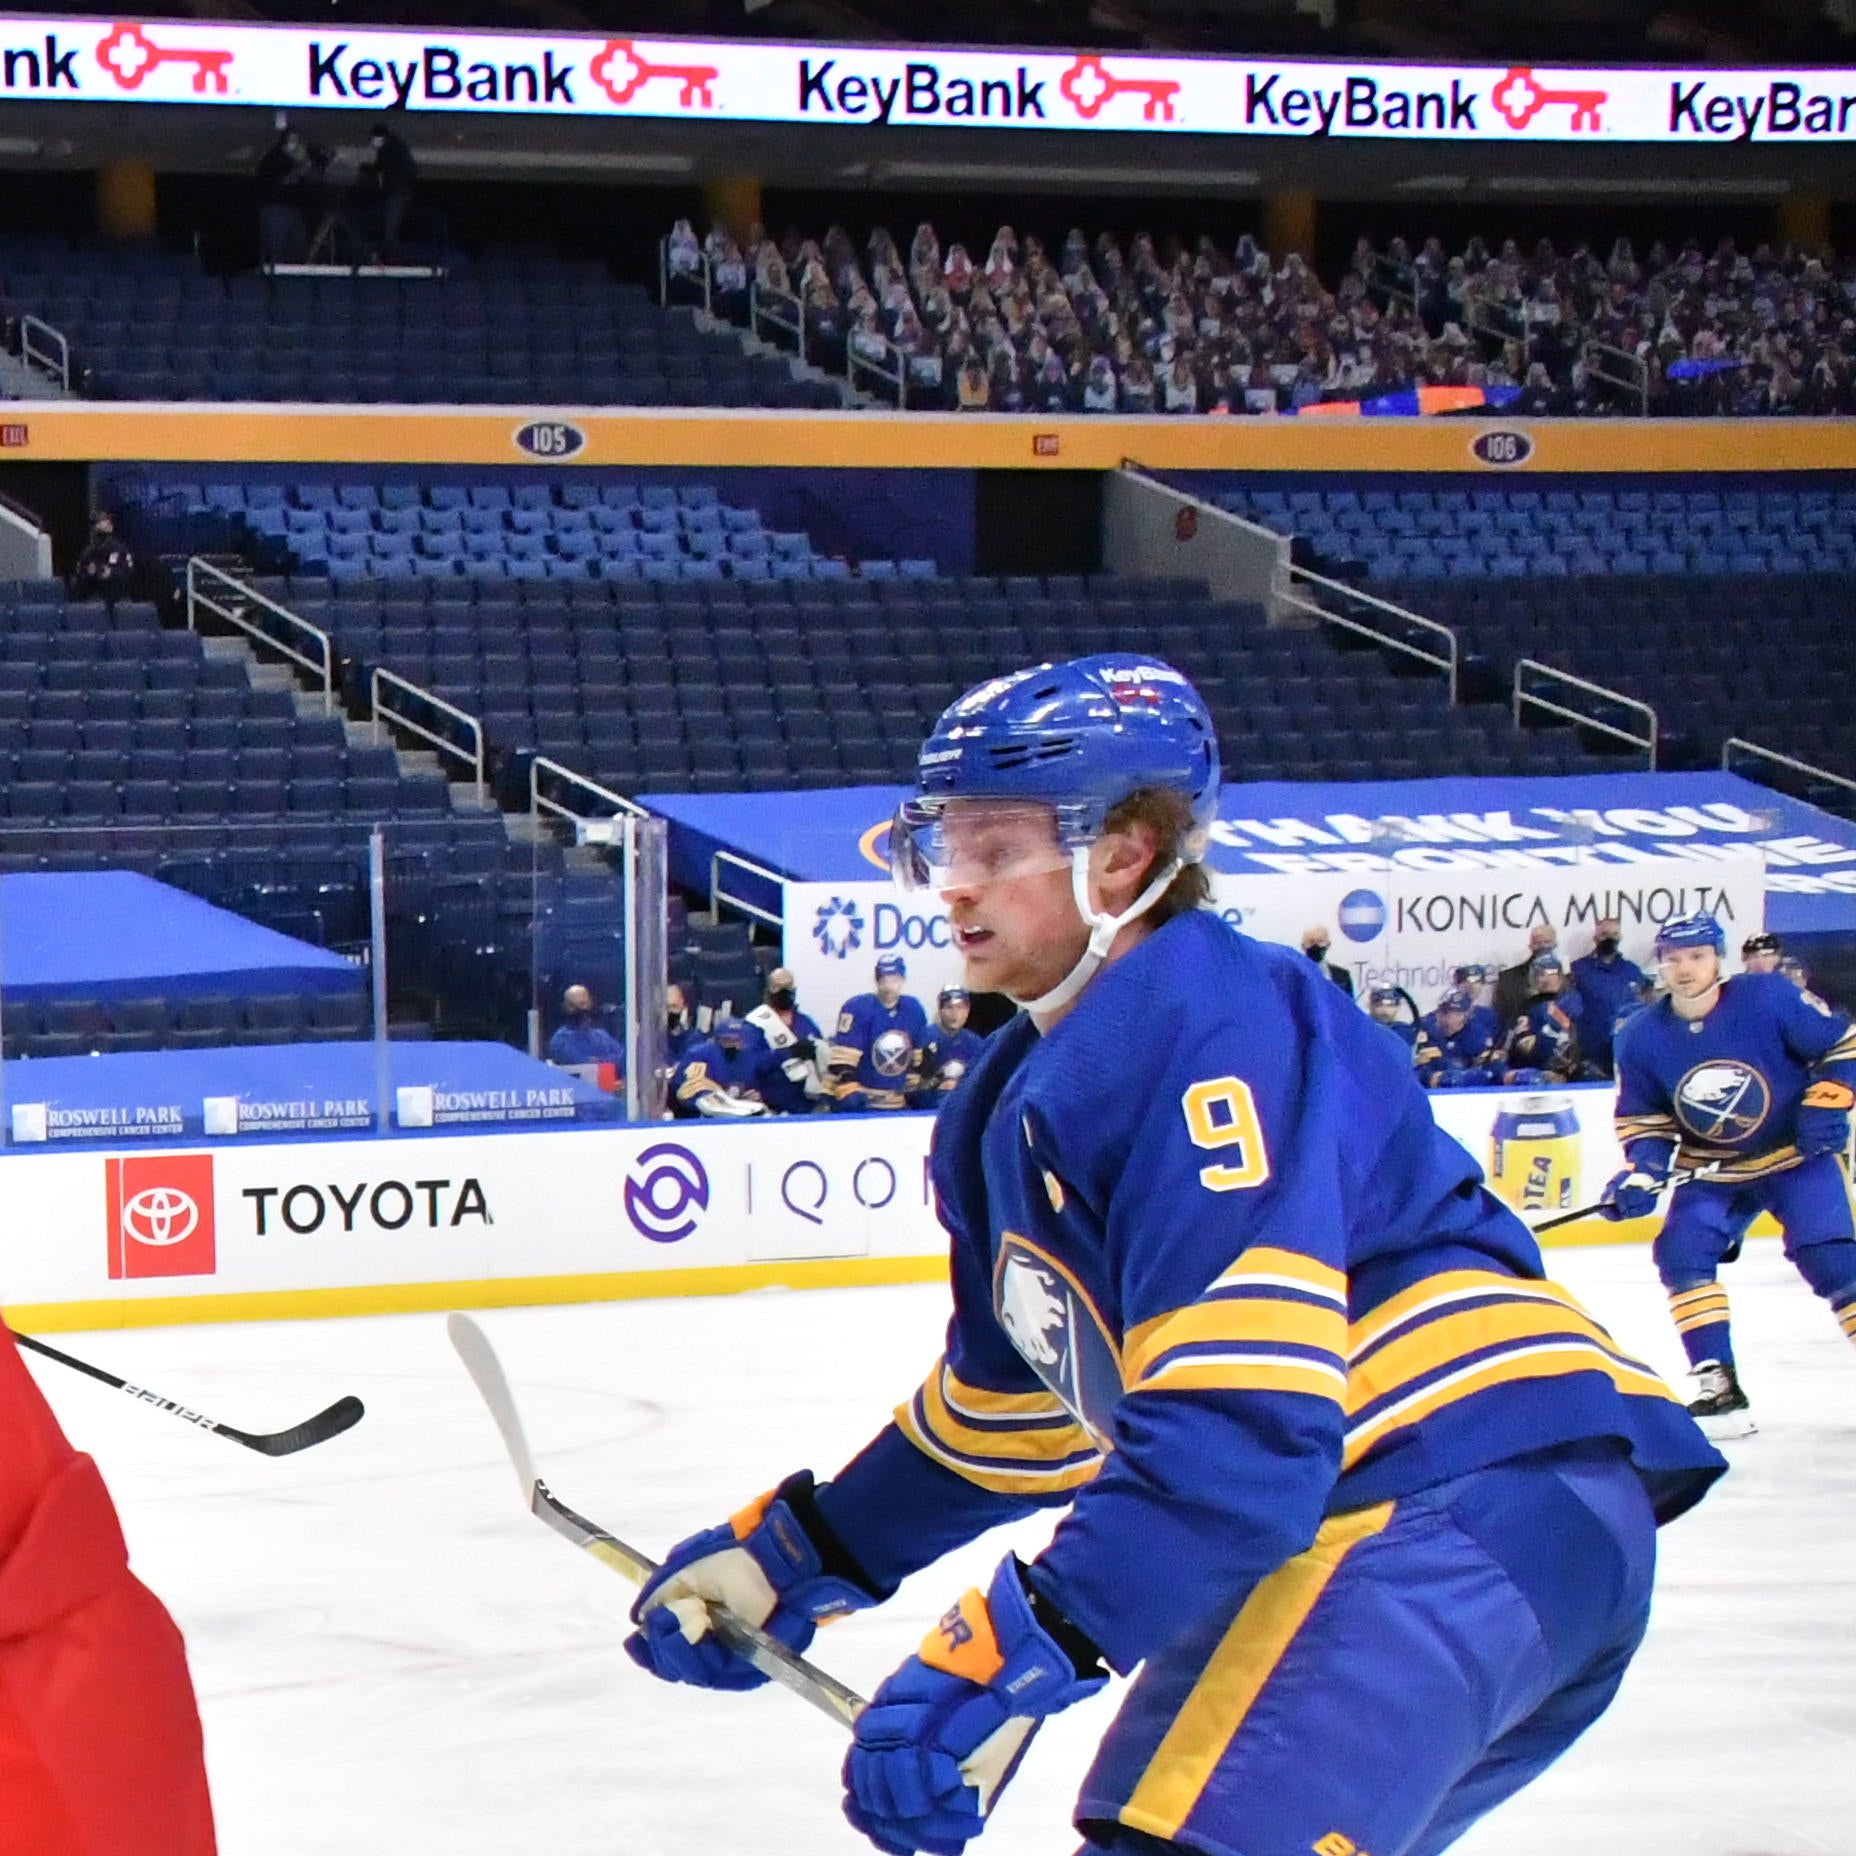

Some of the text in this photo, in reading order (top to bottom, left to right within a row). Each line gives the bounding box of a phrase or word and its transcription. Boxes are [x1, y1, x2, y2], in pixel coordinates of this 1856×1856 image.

[308, 42, 575, 108] KeyBank
[798, 60, 1046, 122] KeyBank
[1245, 74, 1478, 137] KeyBank
[1669, 81, 1856, 141] KeyBa
[532, 421, 566, 452] 105
[1529, 803, 1770, 837] YOU
[873, 902, 951, 950] Doc
[1395, 886, 1734, 933] KONICA MINOLTA
[48, 1105, 183, 1127] ROSWELL PARK
[238, 1100, 370, 1121] ROSWELL PARK
[433, 1088, 575, 1112] ROSWELL PARK
[1181, 1076, 1270, 1192] 9
[241, 1177, 494, 1237] TOYOTA
